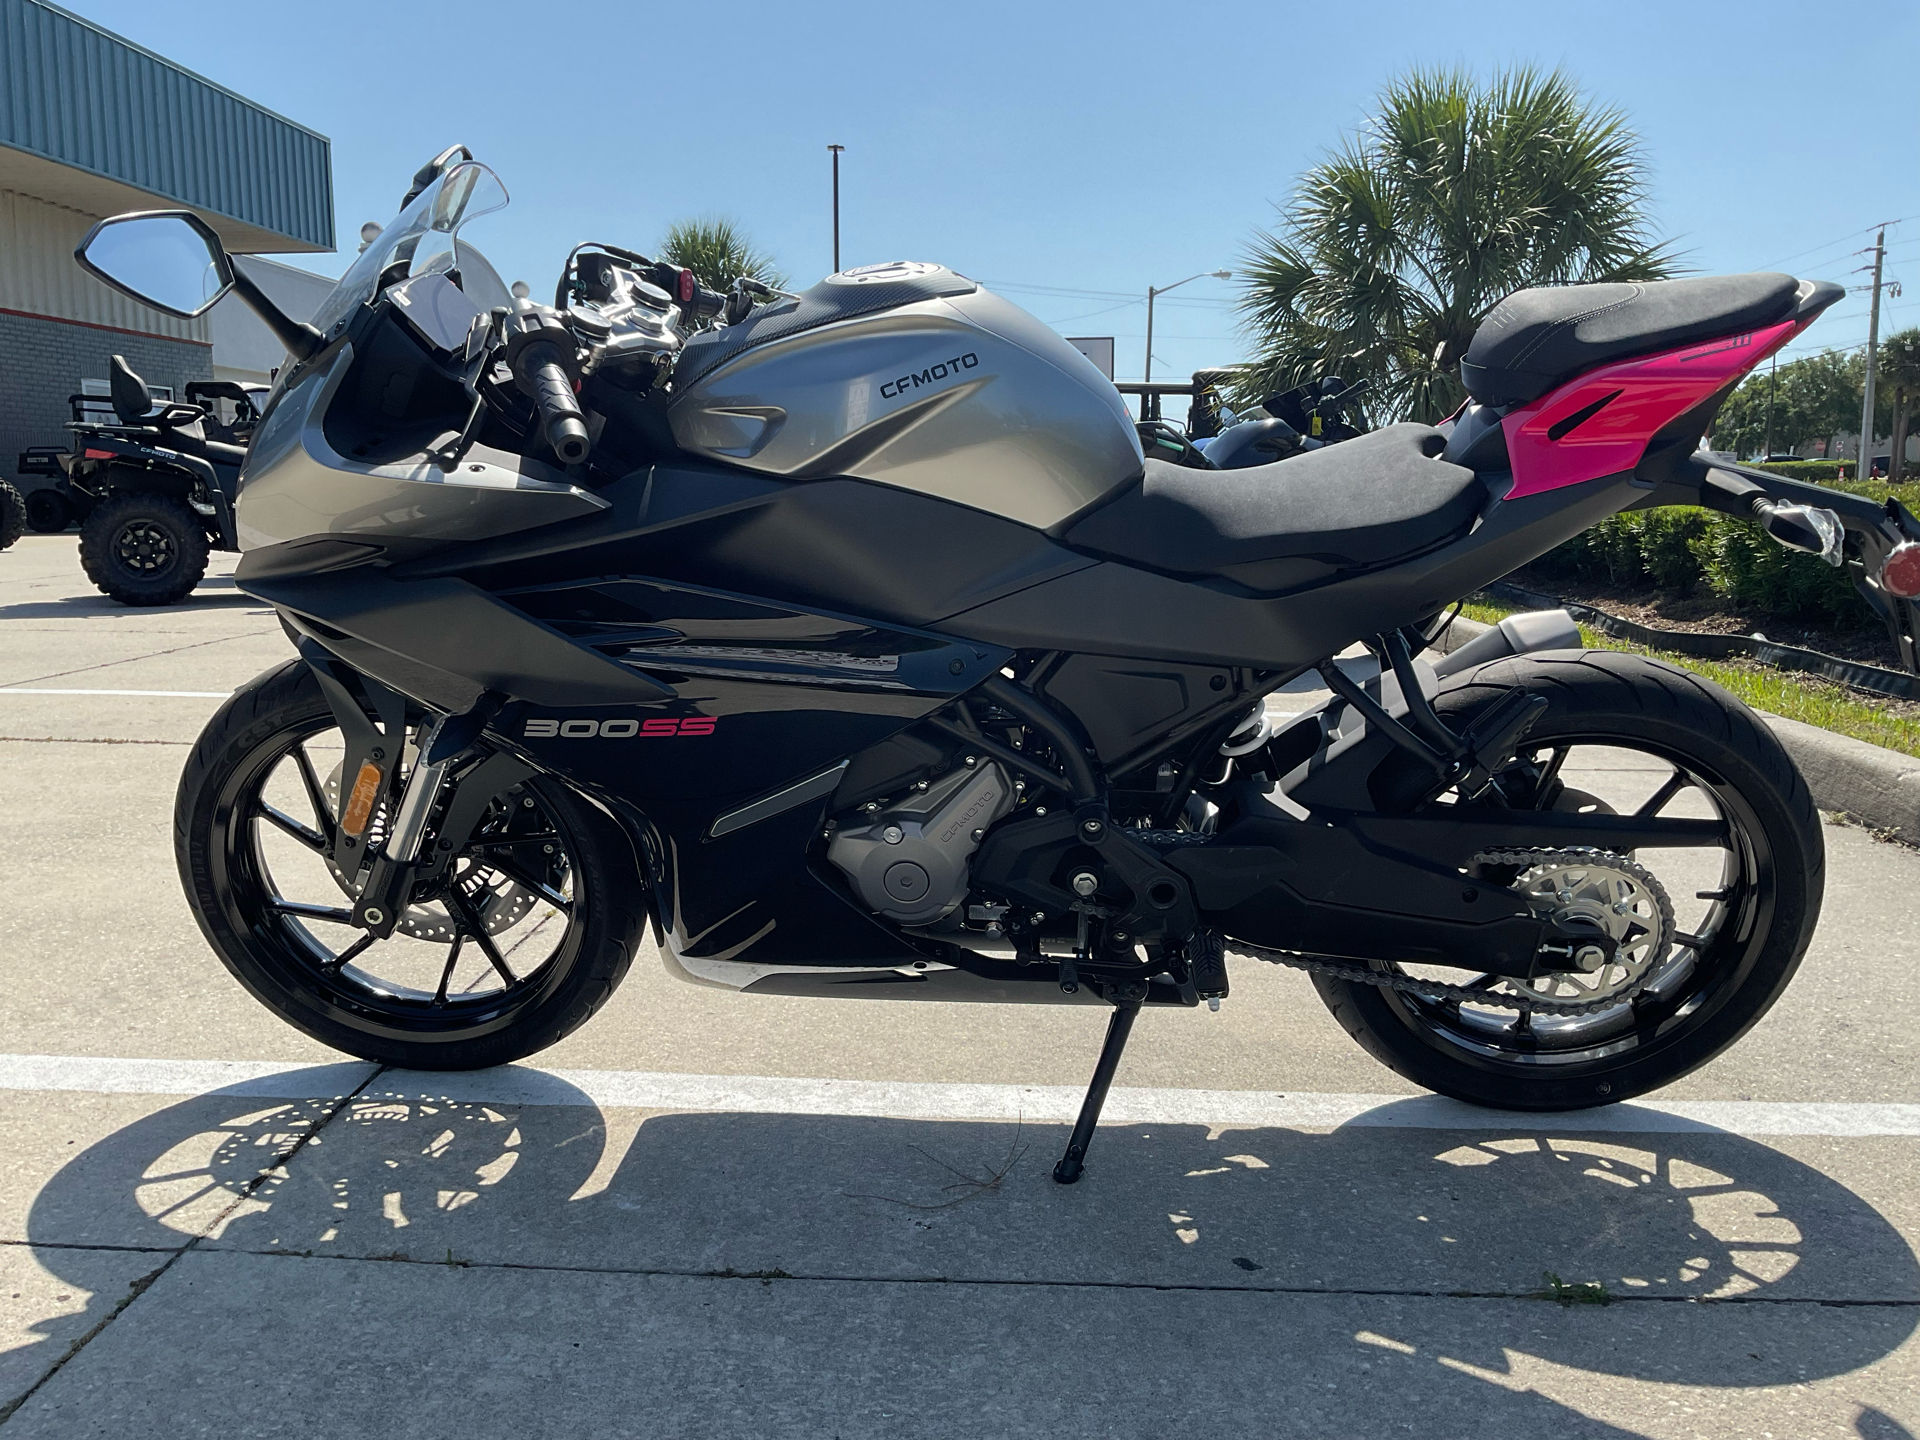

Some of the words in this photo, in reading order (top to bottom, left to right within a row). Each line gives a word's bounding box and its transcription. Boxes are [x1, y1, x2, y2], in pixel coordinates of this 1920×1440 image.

[880, 352, 979, 399] CFMOTO
[140, 446, 176, 460] CFMOTO
[237, 711, 284, 749] CST
[523, 716, 718, 738] 300SS
[940, 790, 995, 843] CFMOTO
